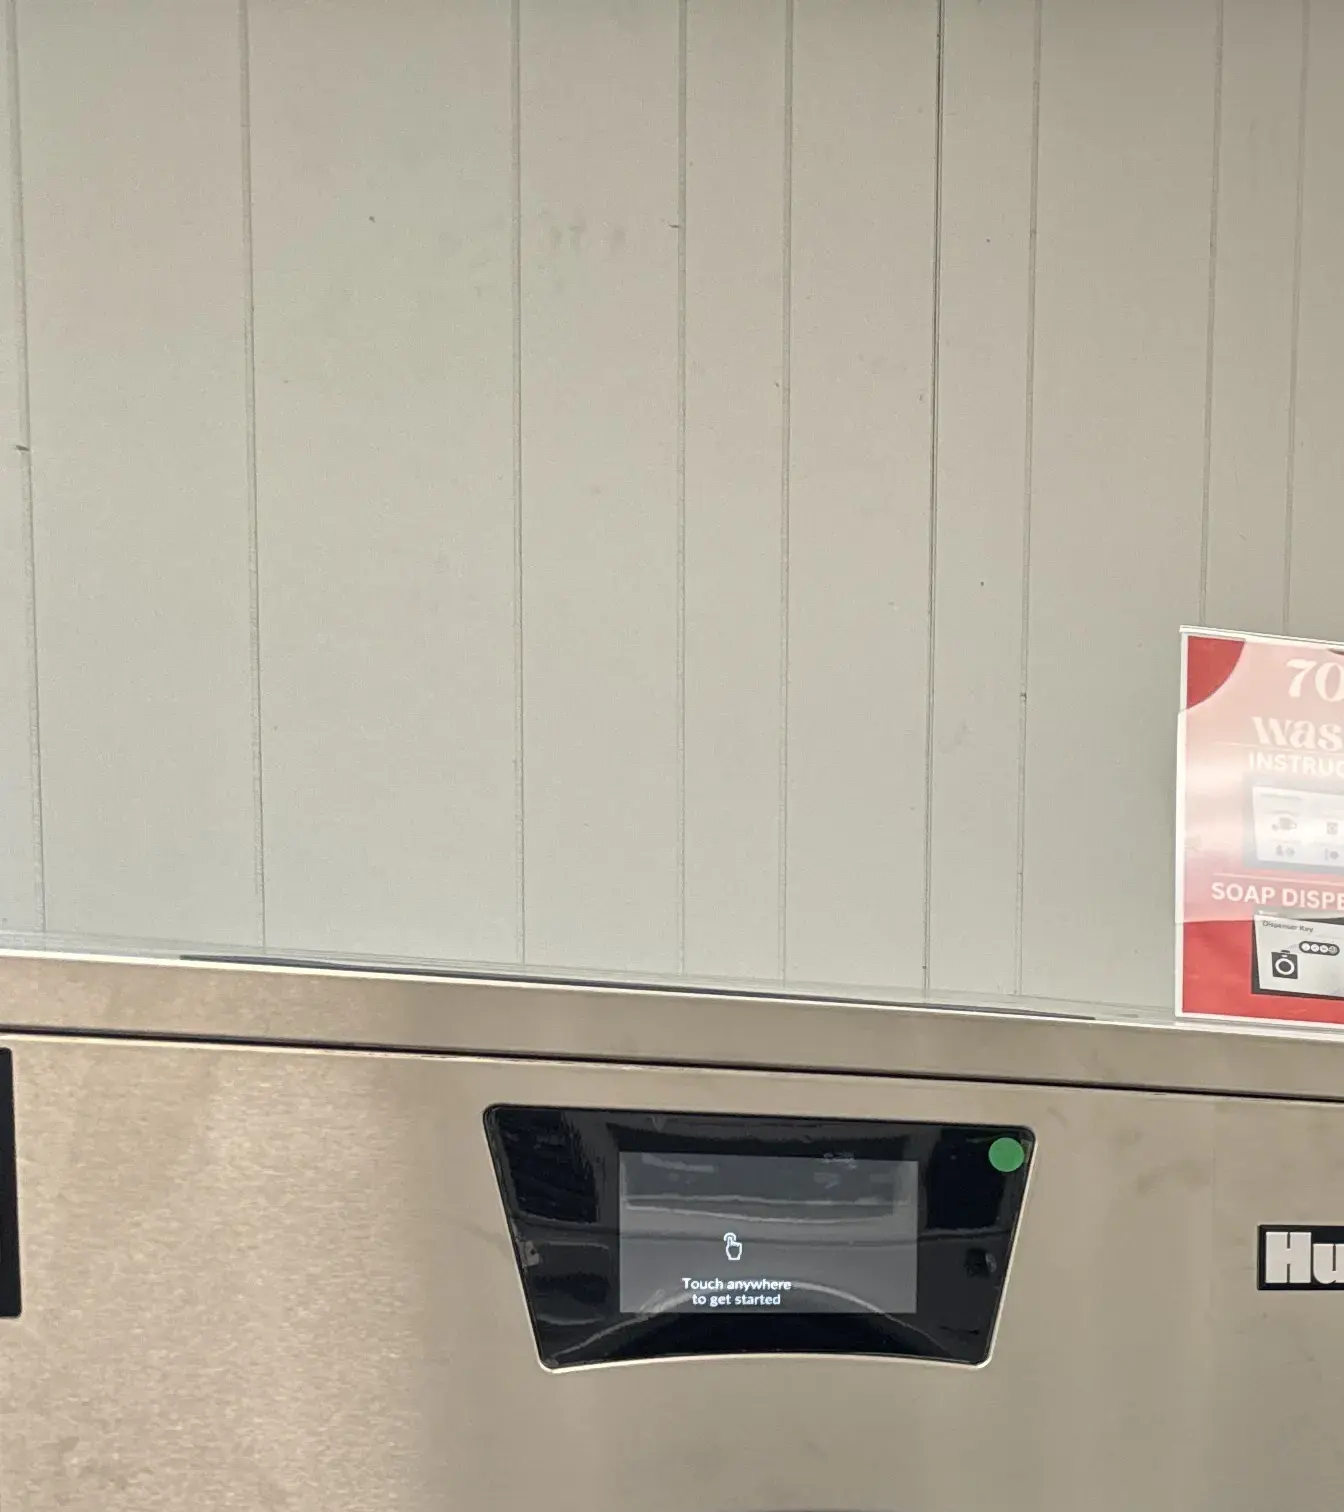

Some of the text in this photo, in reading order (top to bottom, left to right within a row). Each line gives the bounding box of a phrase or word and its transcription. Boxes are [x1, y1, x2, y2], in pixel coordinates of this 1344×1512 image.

[1211, 882, 1275, 905] SOAP
[682, 1278, 792, 1292] Touch anywhere
[692, 1294, 781, 1307] to get started
